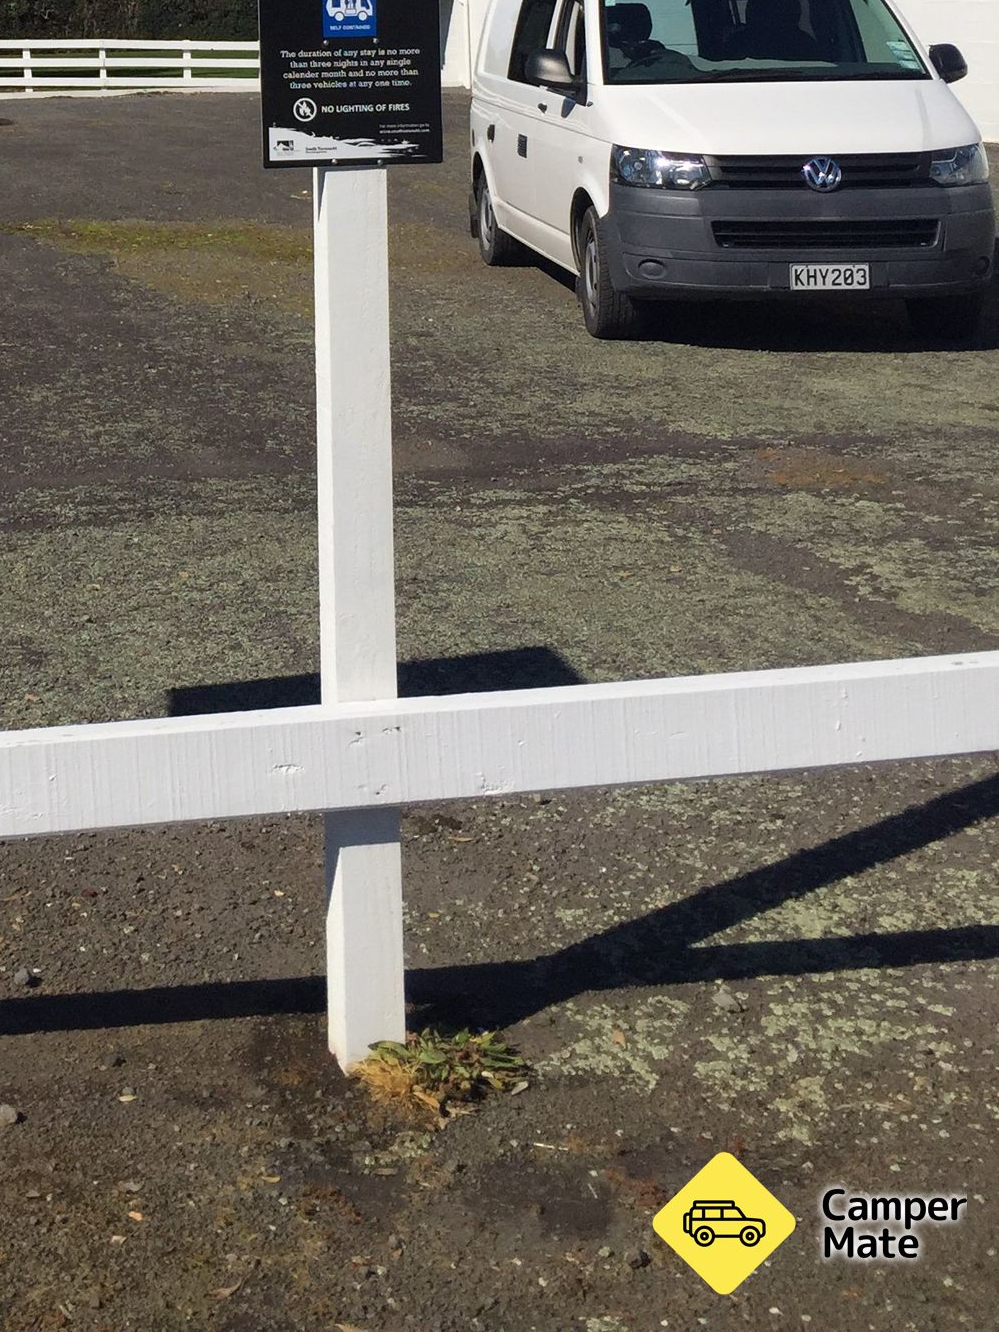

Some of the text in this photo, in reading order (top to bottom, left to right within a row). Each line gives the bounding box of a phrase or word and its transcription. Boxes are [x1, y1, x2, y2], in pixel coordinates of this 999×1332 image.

[280, 50, 296, 58] The
[298, 50, 332, 58] duration
[333, 48, 342, 57] of
[343, 50, 358, 59] any
[360, 49, 376, 58] stay
[378, 48, 386, 56] is
[290, 58, 411, 69] than three nights in any single
[321, 70, 346, 78] month
[348, 69, 364, 78] and
[400, 68, 418, 76] than
[290, 81, 312, 90] three
[313, 80, 347, 88] vehicles
[358, 80, 372, 89] any
[322, 102, 410, 113] NO LIGHTING OF FIRES
[794, 268, 867, 286] KHY203
